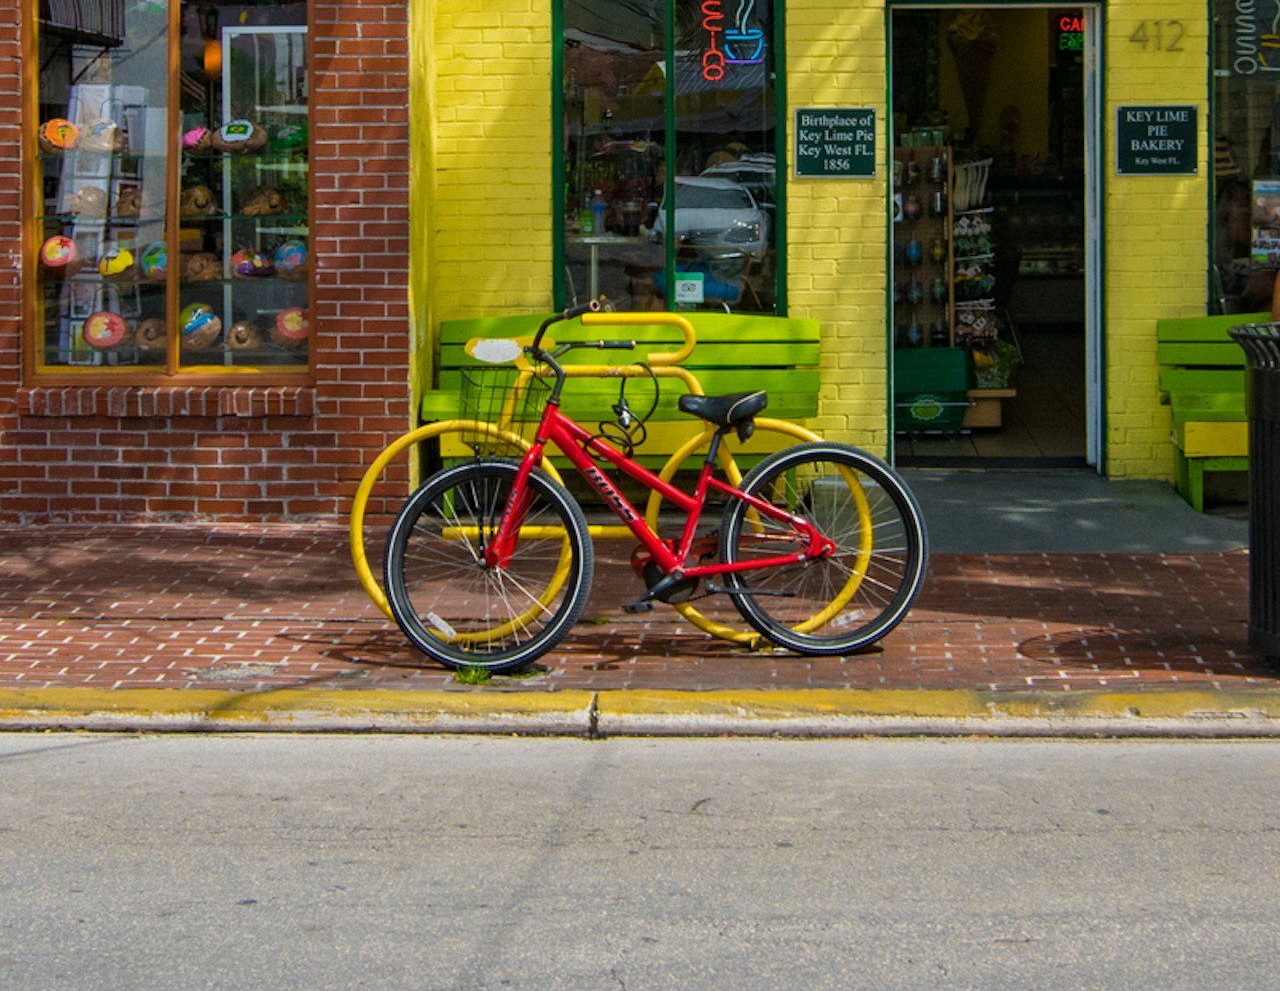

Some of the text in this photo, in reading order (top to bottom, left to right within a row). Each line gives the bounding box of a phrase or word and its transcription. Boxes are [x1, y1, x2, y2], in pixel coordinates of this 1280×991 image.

[1128, 19, 1185, 51] 412
[801, 114, 873, 129] Birthplace of
[1126, 111, 1189, 122] KEY LIME
[1147, 125, 1168, 136] PIE
[799, 130, 874, 144] Key Lime Pie
[798, 144, 874, 158] Key West FL.
[1131, 139, 1184, 151] BAKERY
[823, 159, 850, 171] 1856
[1135, 157, 1150, 166] Key
